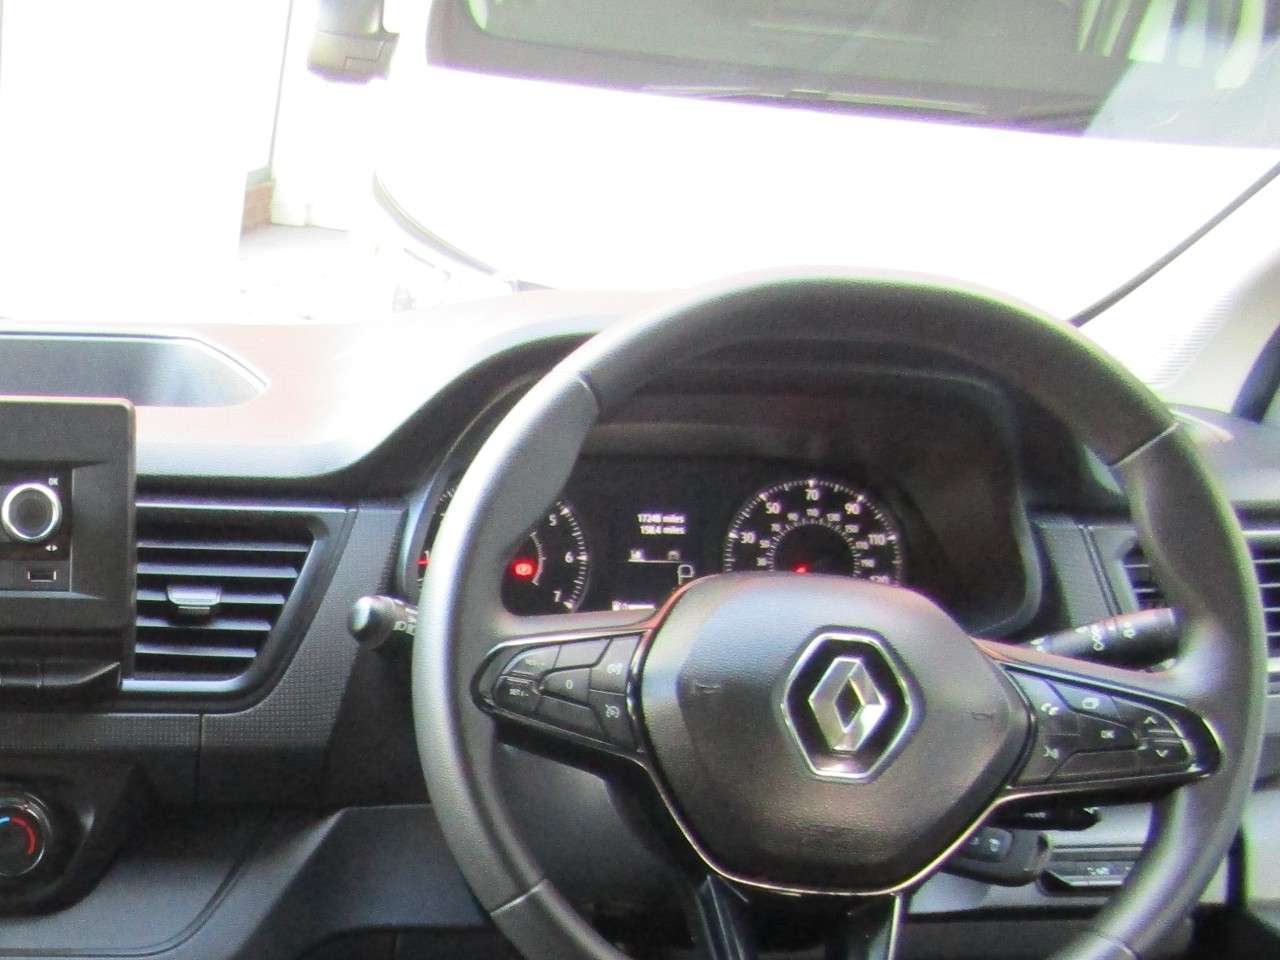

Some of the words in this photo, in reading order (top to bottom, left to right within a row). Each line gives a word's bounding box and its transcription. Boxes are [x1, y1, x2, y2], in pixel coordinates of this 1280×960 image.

[806, 489, 819, 500] 70
[766, 502, 780, 514] 50
[845, 502, 860, 514] 90
[549, 514, 557, 526] 5
[741, 531, 755, 543] 30
[869, 533, 886, 545] 110
[565, 552, 573, 563] 6
[553, 590, 561, 602] 7
[1100, 730, 1115, 739] OK
